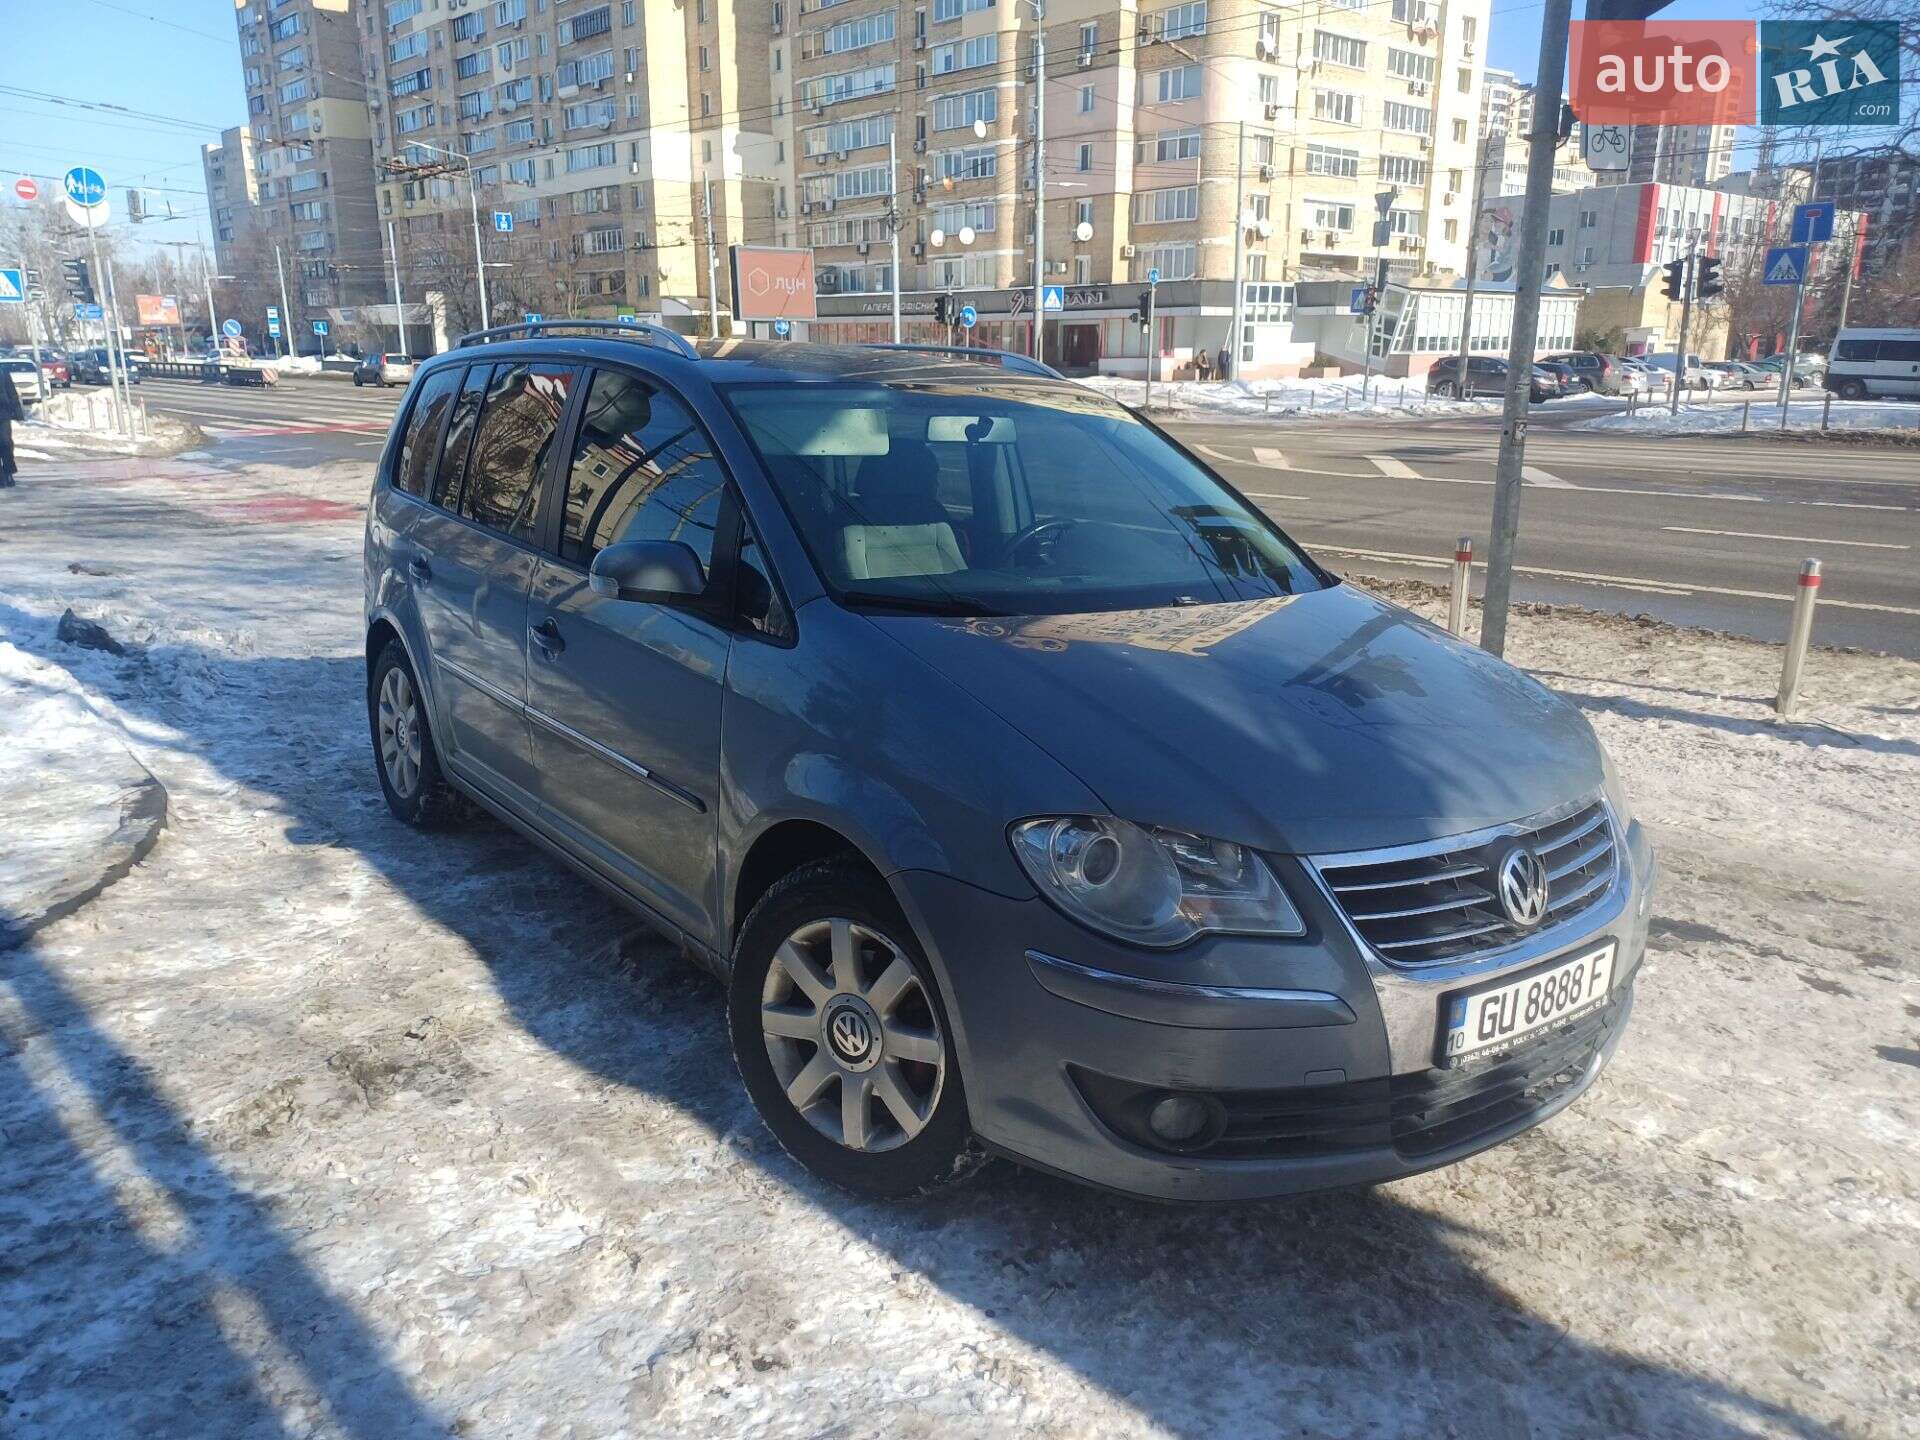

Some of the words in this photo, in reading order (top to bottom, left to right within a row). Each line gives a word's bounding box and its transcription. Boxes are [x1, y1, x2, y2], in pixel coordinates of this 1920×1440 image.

[1477, 988, 1520, 1041] GU
[1524, 963, 1585, 1024] 8888
[1588, 953, 1606, 998] F
